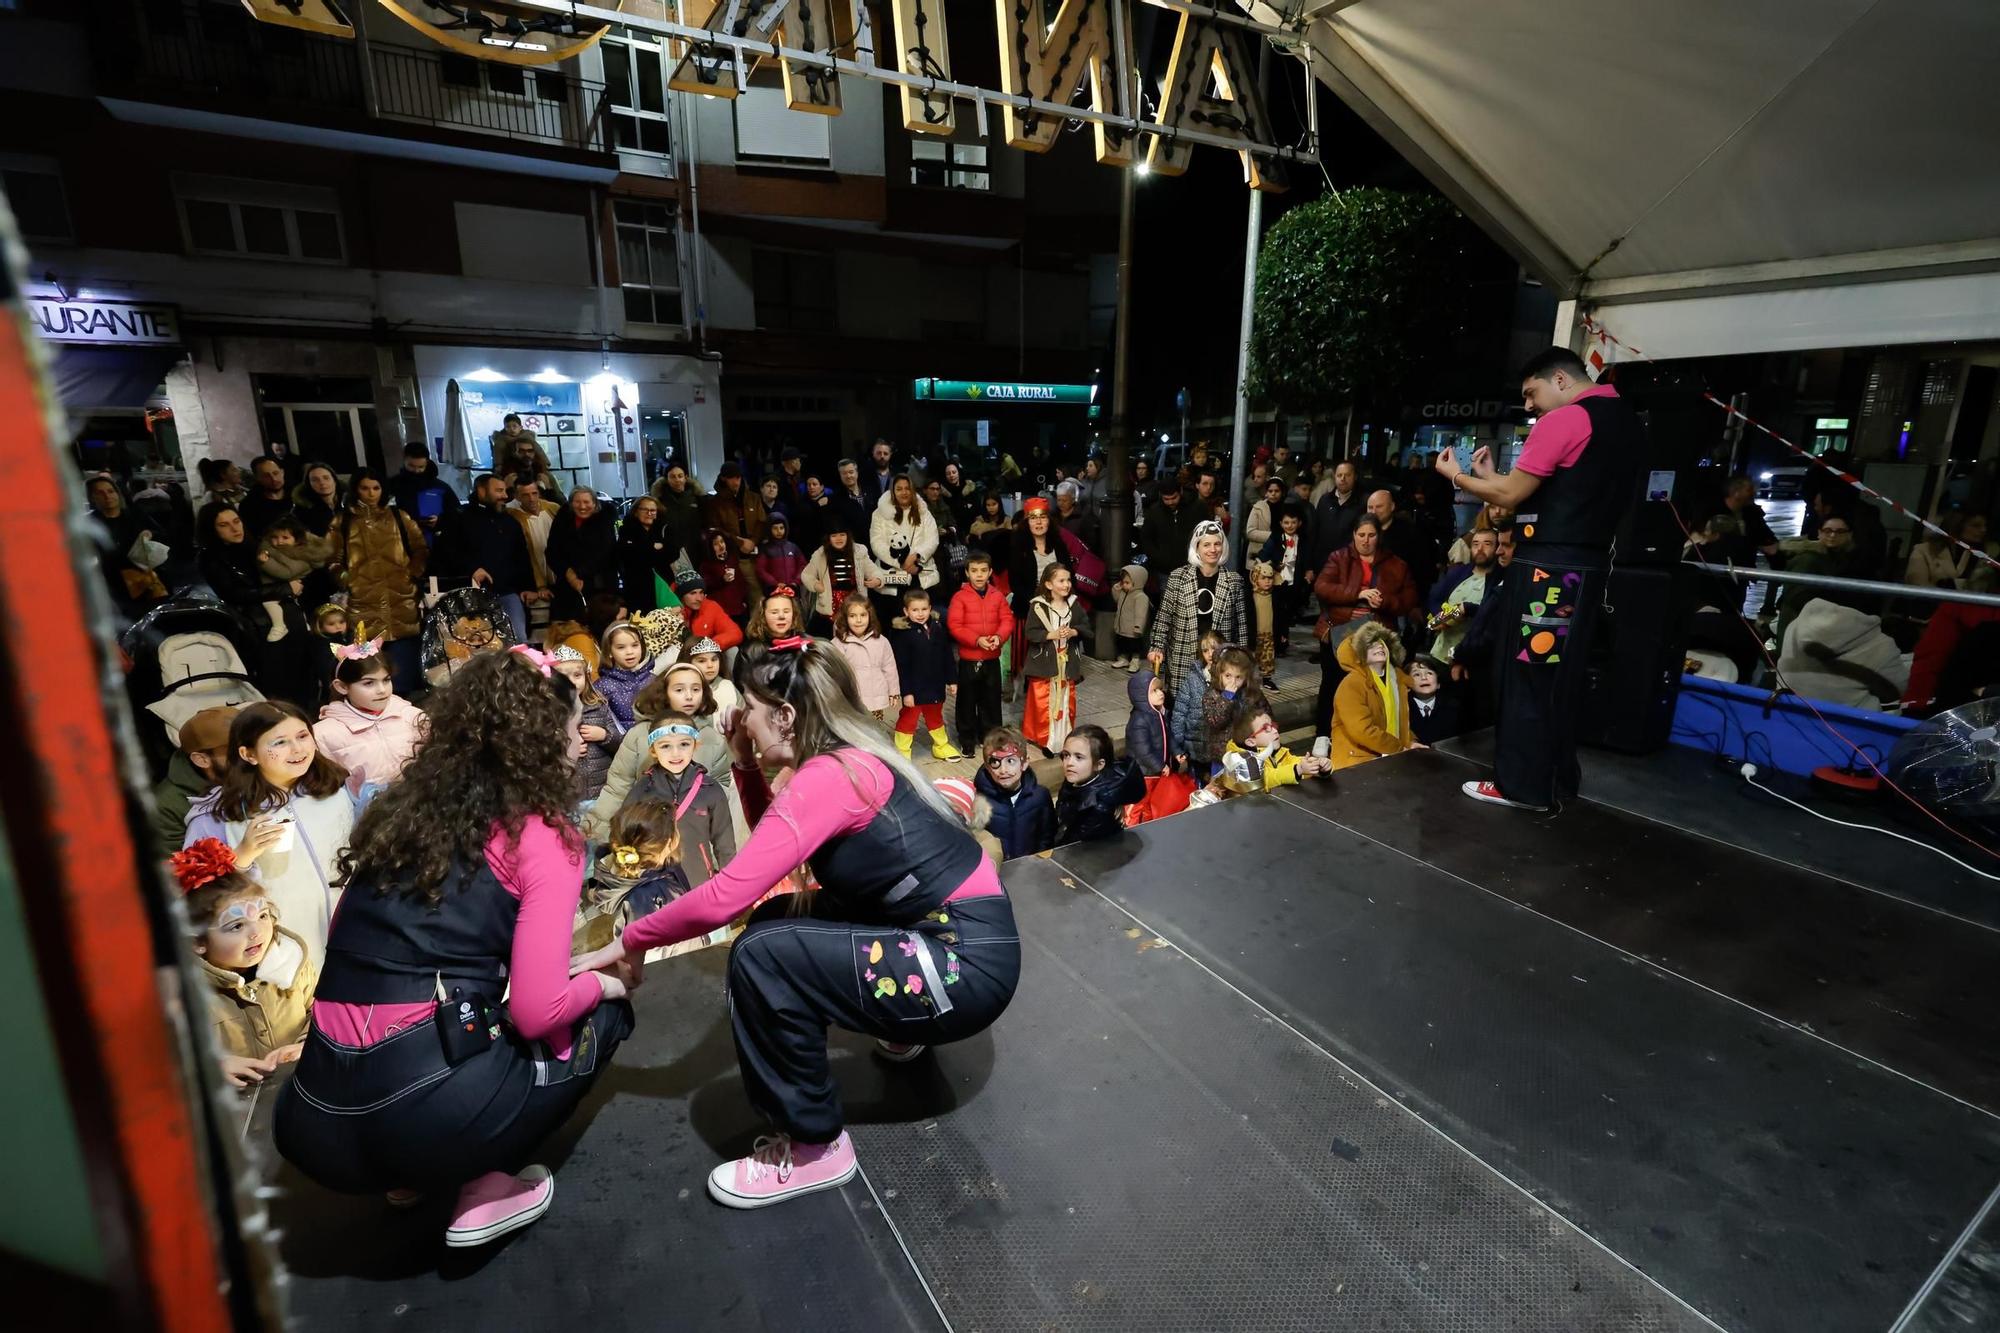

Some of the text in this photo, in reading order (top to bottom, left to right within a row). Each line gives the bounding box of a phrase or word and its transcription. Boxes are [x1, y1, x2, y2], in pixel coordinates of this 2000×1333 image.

[986, 385, 1056, 399] CAJA RURAL
[1422, 400, 1478, 418] crisol
